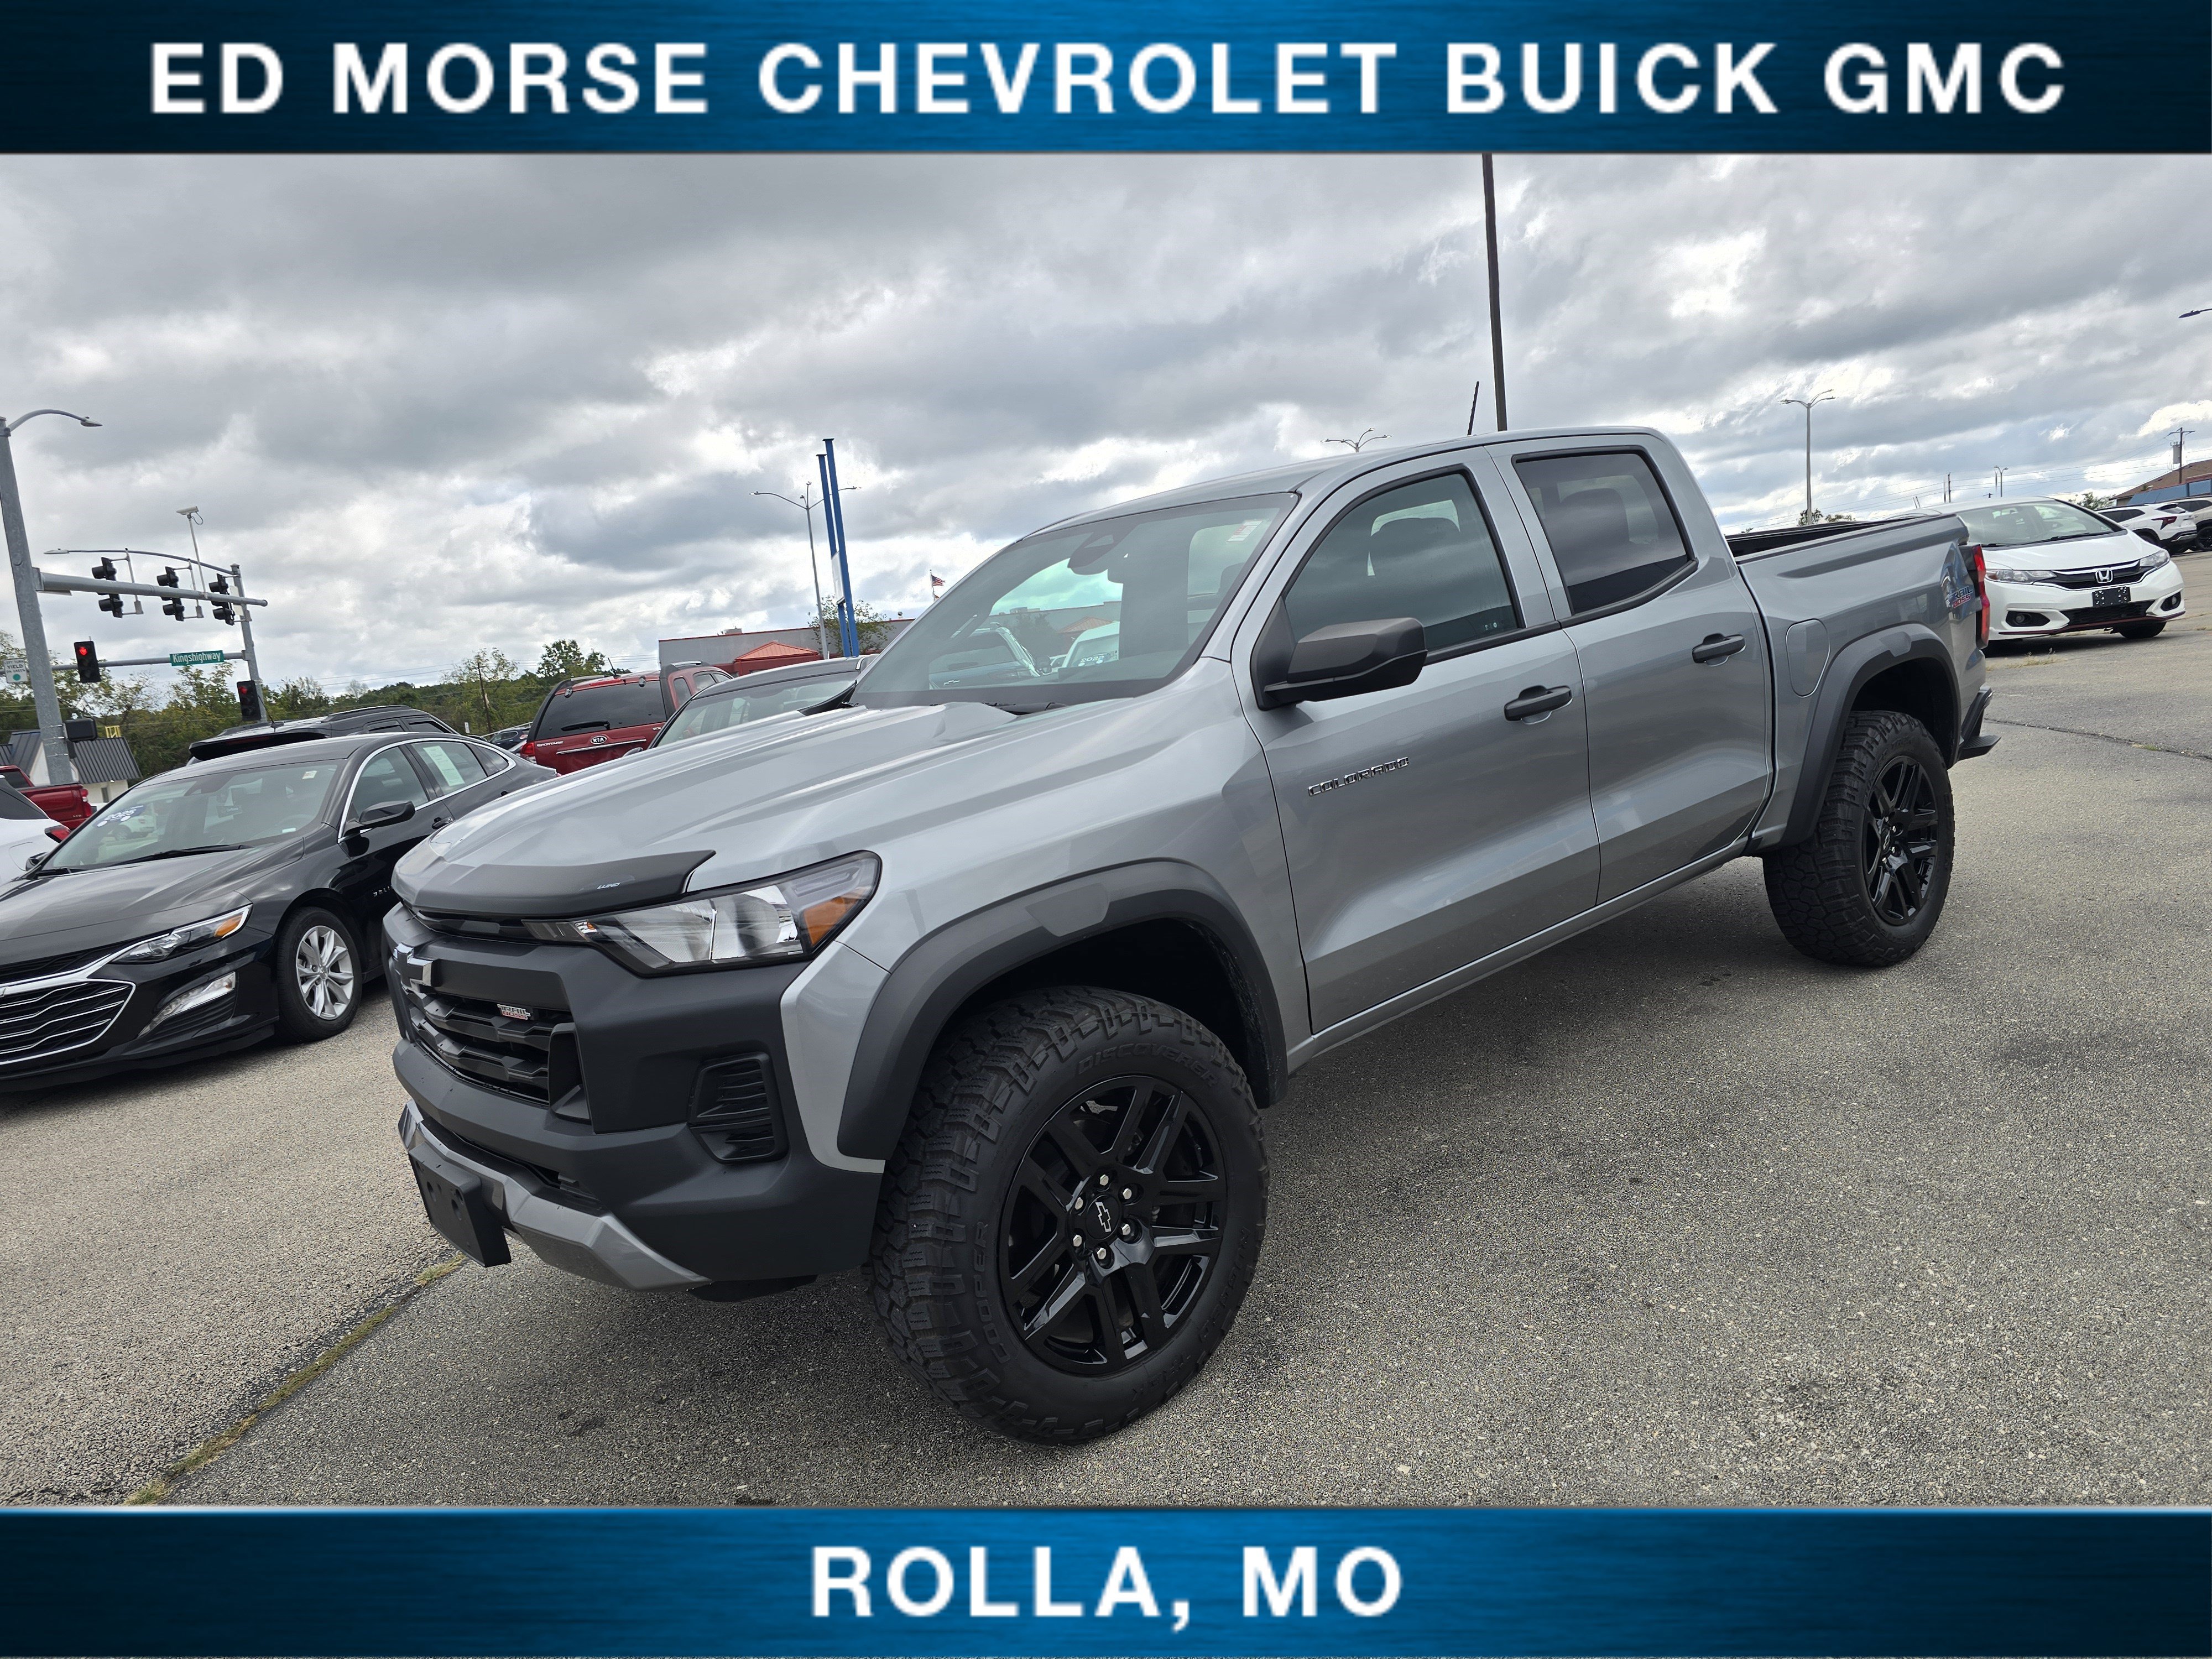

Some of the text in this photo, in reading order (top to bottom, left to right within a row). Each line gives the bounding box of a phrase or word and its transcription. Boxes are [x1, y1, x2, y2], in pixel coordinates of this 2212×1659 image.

[172, 652, 221, 664] Kingshighway
[1308, 757, 1409, 796] COLORADO
[497, 1004, 531, 1016] TRAIL
[502, 1010, 528, 1020] BOSS
[1077, 1042, 1218, 1087] DISCOVERER
[974, 1220, 1013, 1364] COOPER
